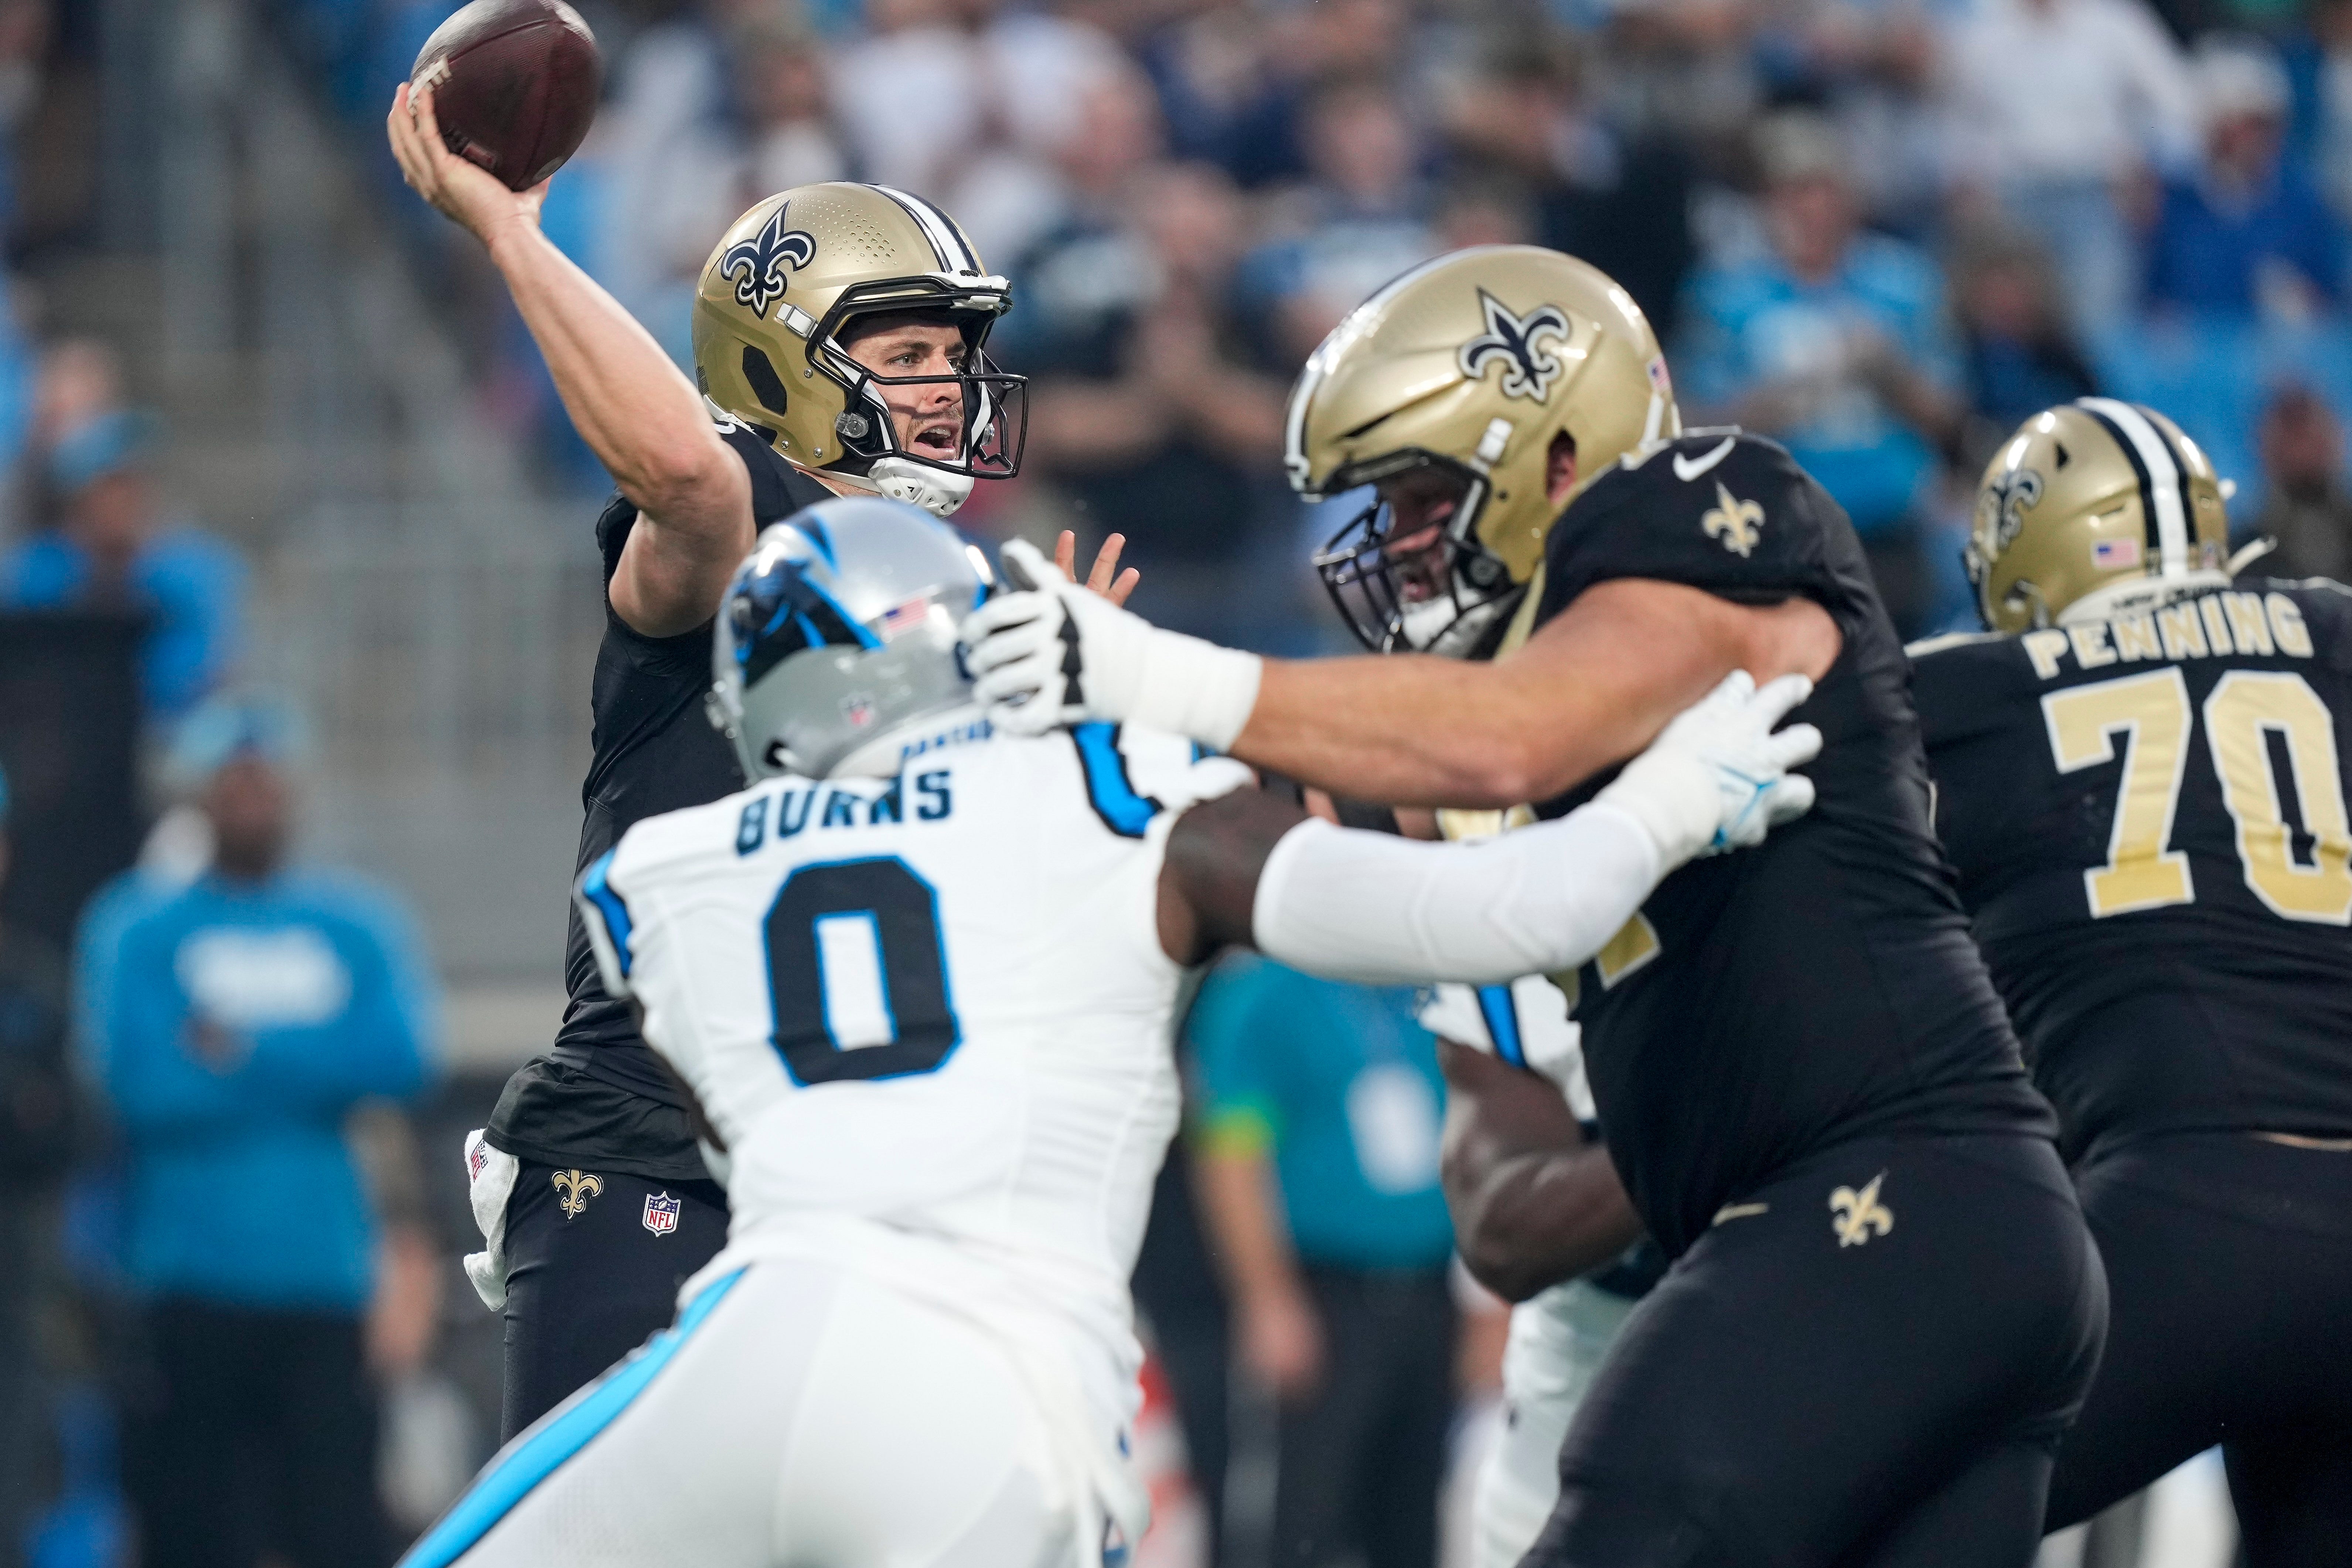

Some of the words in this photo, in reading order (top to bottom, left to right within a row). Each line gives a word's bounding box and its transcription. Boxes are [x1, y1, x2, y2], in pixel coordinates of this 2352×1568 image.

[2022, 591, 2314, 680] PENNING
[736, 770, 952, 857] BURNS
[2040, 666, 2352, 925] 70
[762, 853, 963, 1089] 0
[648, 1210, 672, 1229] NFL
